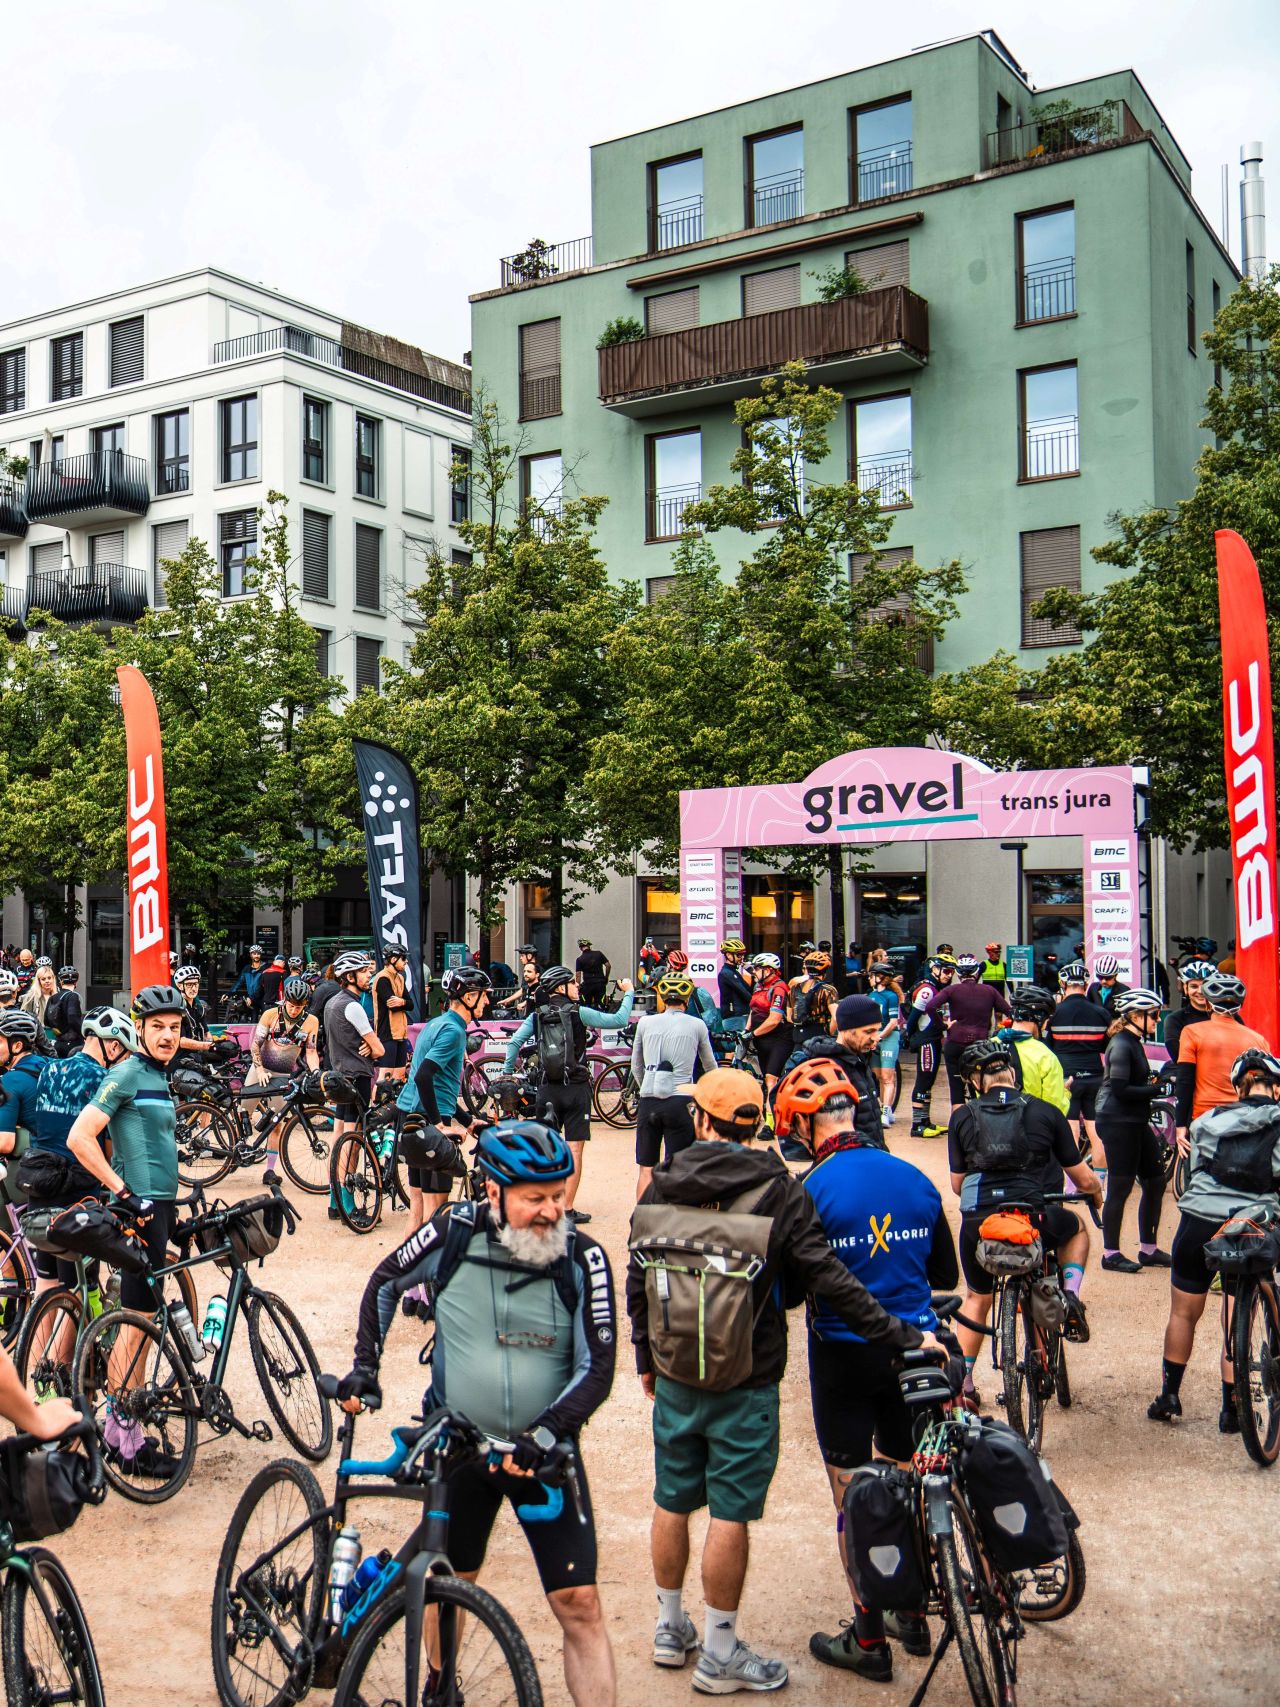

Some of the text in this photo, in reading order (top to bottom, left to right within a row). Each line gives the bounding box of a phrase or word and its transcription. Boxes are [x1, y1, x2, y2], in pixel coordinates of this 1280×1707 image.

[803, 763, 1111, 834] gravel trans jura
[1094, 847, 1126, 856] BMC
